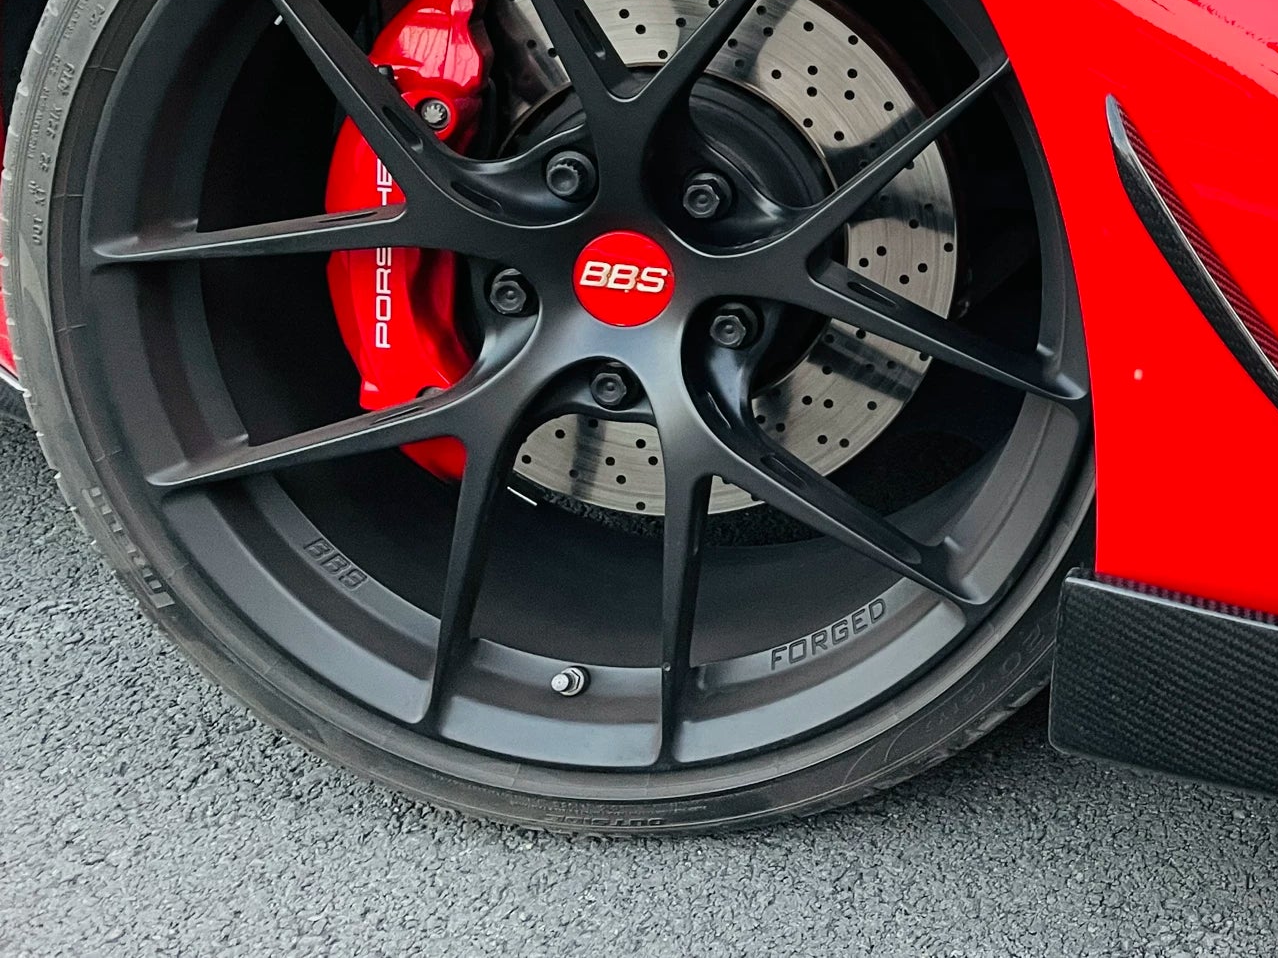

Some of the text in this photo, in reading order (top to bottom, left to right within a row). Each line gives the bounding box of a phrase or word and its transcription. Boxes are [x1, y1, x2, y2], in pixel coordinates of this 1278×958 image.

[375, 158, 393, 349] PORSHE
[578, 260, 669, 293] BBS
[303, 537, 369, 591] BBS
[770, 598, 887, 670] FORGED
